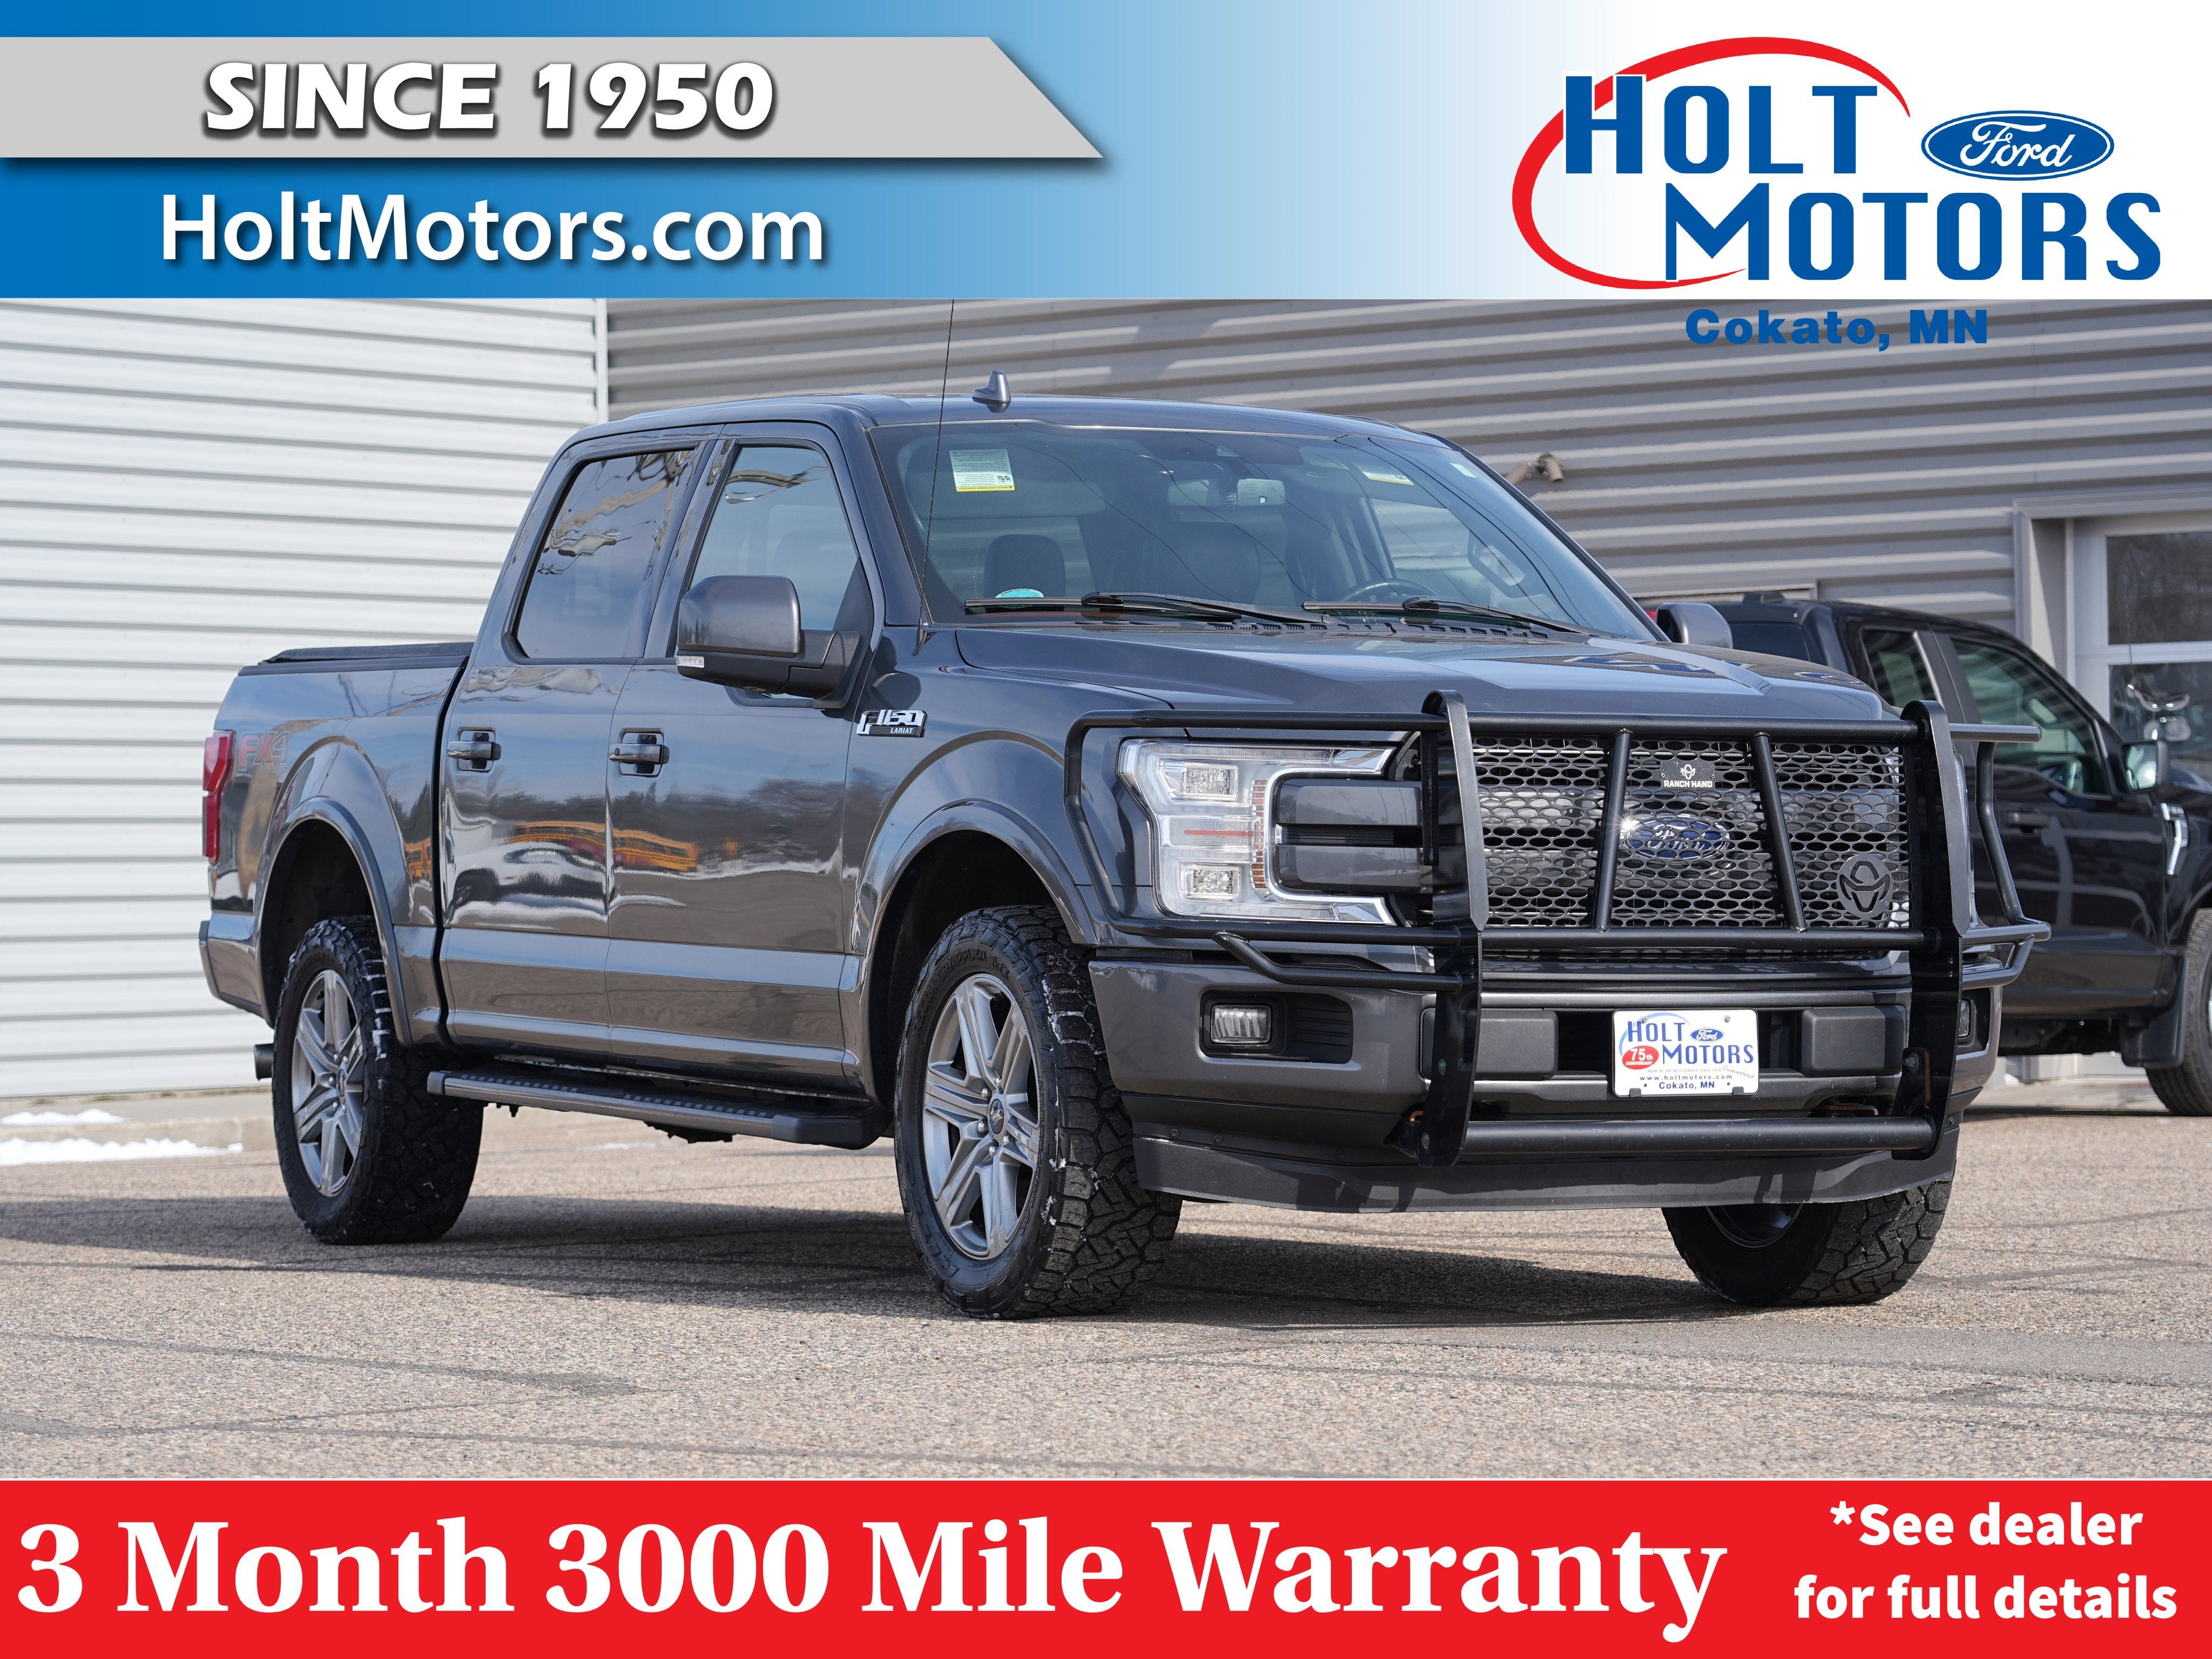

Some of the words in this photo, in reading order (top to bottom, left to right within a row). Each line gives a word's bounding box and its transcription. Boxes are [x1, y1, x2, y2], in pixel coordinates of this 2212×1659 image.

[237, 731, 291, 772] FX4
[1663, 780, 1690, 788] RANCH
[1627, 1020, 1686, 1042] HOLT
[1696, 1029, 1718, 1041] Ford
[1630, 1048, 1654, 1062] 75th
[1662, 1043, 1754, 1065] MOTORS
[1723, 1065, 1755, 1078] Guaranteed
[1658, 1081, 1697, 1090] Cokato,
[1700, 1081, 1715, 1089] MN
